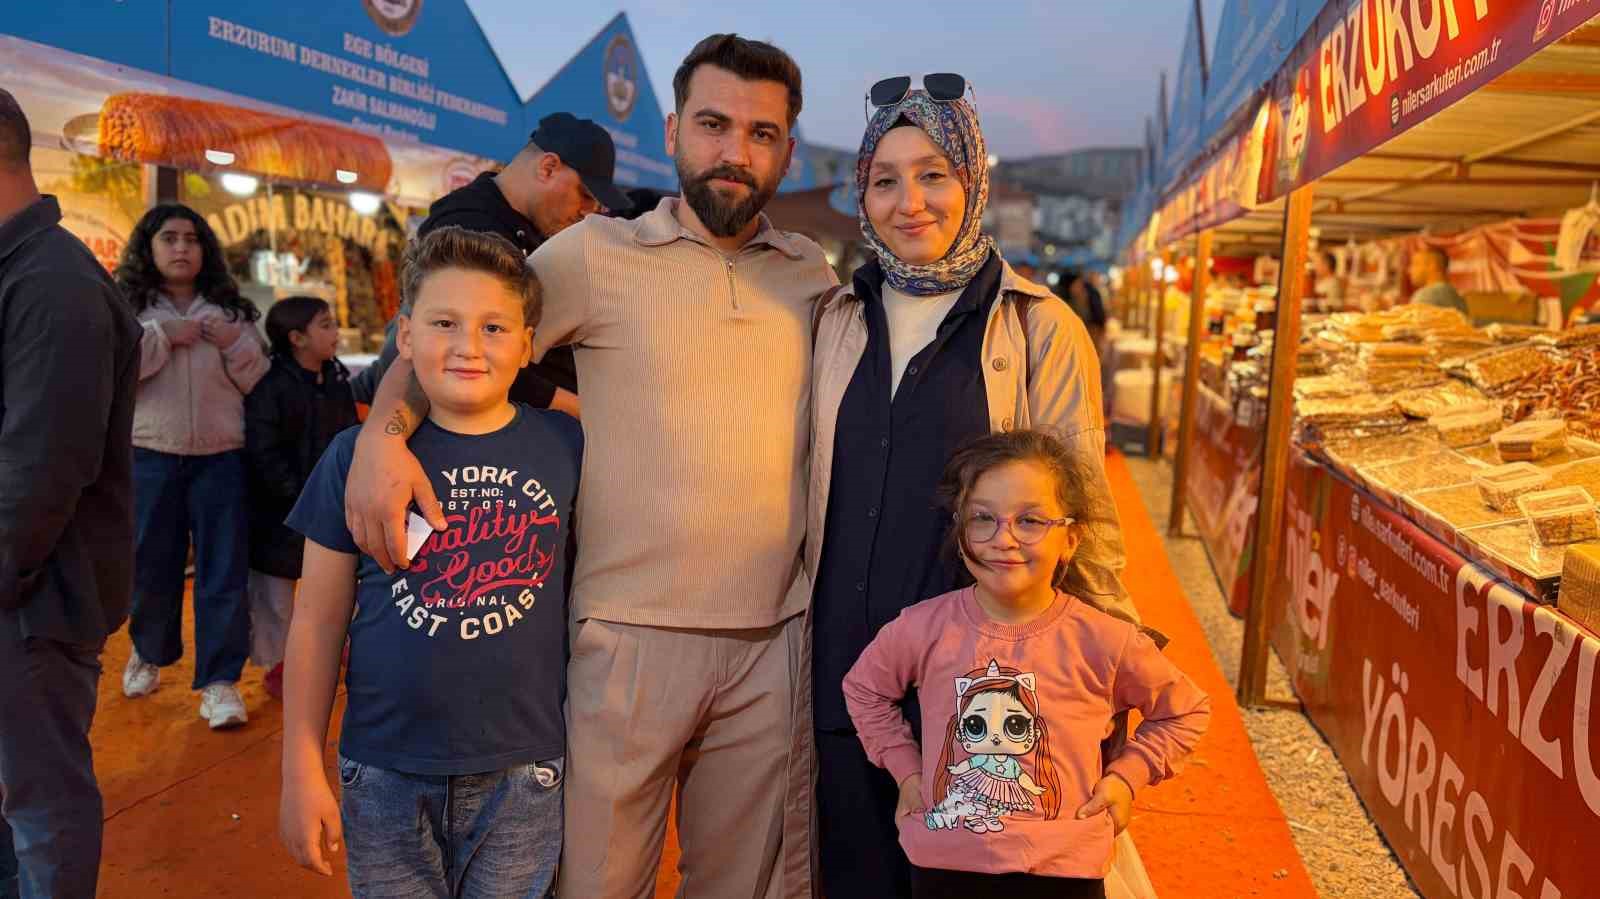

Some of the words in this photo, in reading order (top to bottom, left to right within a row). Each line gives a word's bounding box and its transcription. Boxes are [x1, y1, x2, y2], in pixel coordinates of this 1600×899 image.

[208, 16, 297, 62] ERZURUM
[299, 46, 387, 89] DERNEKLER
[343, 32, 373, 59] EGE
[1401, 37, 1502, 117] nilersarkuteri.com.tr
[441, 466, 519, 487] YORK
[521, 478, 559, 516] CIT
[450, 487, 504, 498] EST.NO:
[412, 504, 560, 566] uality
[420, 534, 557, 606] Goods
[391, 577, 449, 638] EAST
[1361, 657, 1563, 899] YÖRES
